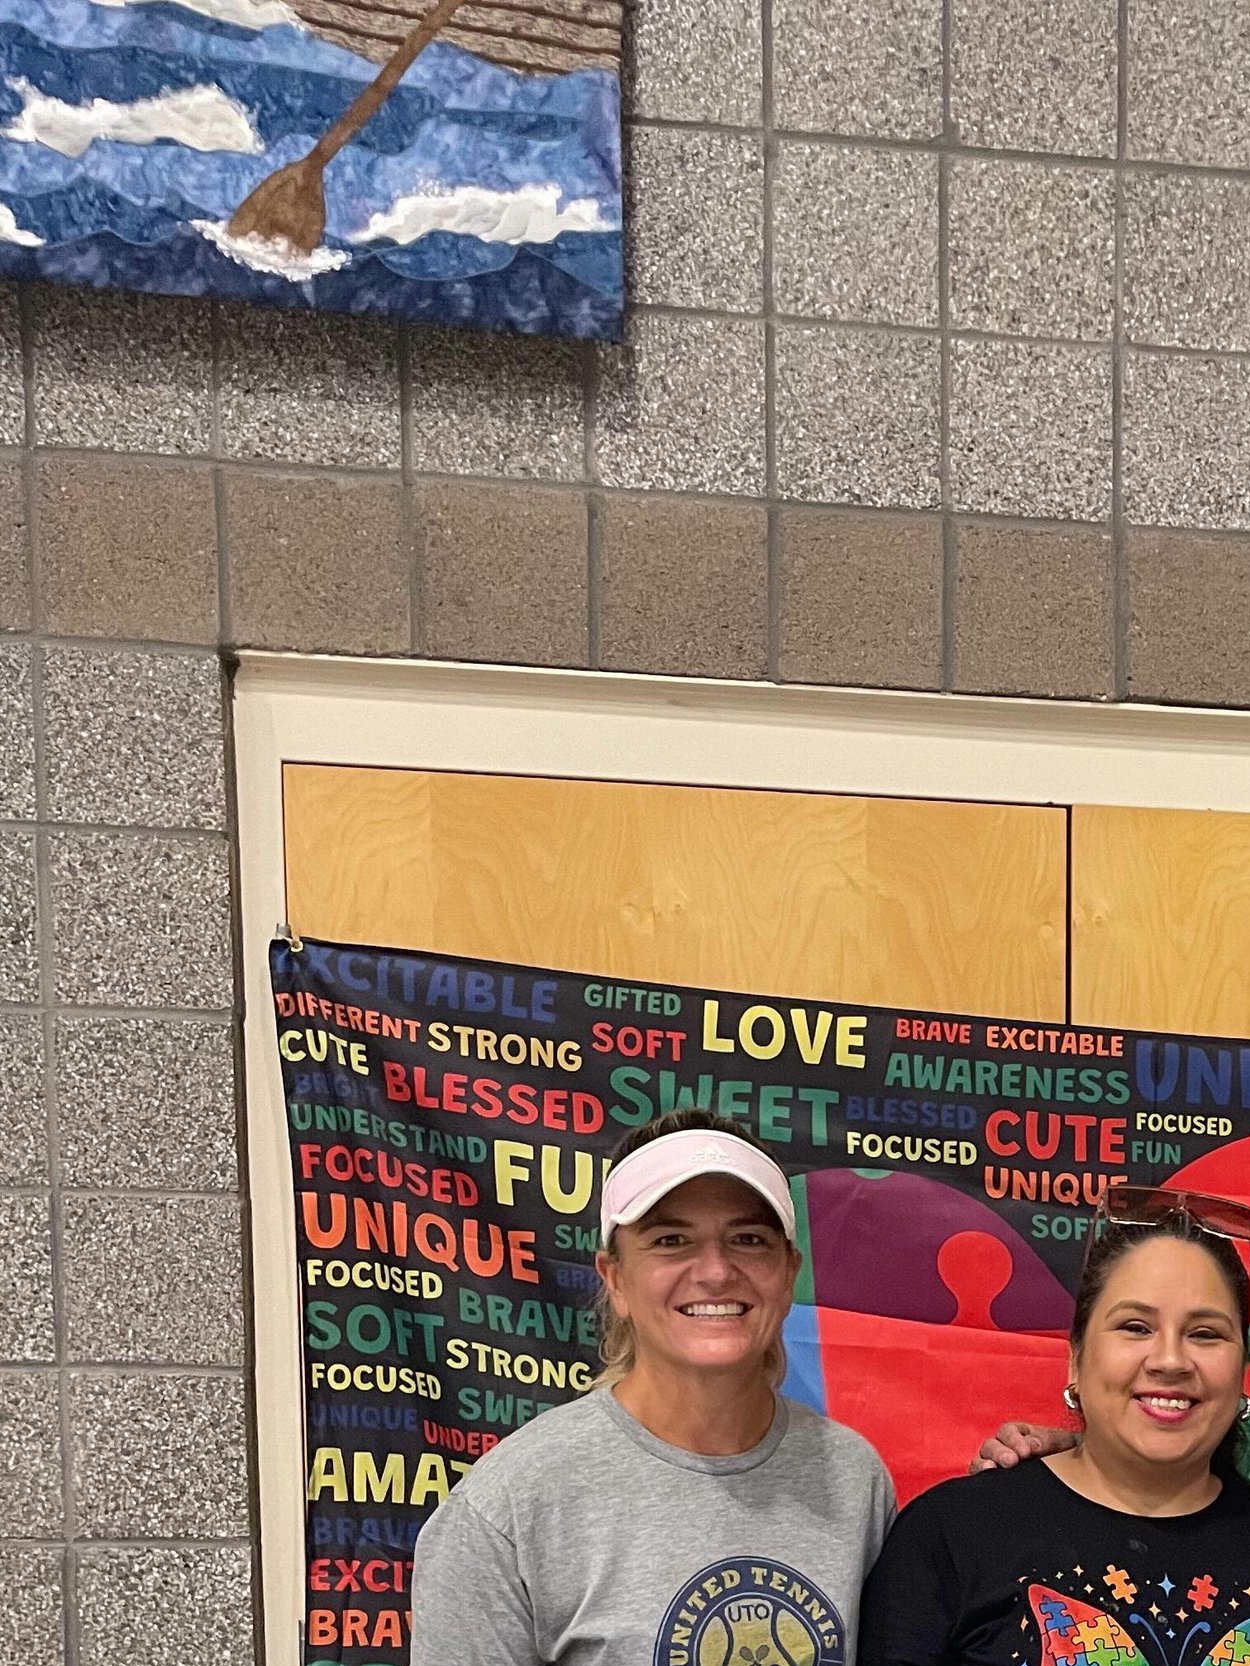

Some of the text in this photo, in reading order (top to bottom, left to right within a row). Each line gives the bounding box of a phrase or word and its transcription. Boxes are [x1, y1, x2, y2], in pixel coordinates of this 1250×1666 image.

[584, 984, 682, 1017] GIFTED
[275, 991, 583, 1072] DIFFERENT STRONG
[280, 1029, 370, 1075] CUTE
[591, 1022, 688, 1062] SOFT
[703, 999, 868, 1068] LOVE
[896, 1018, 1124, 1058] BRAVE EXCITABLE
[383, 1061, 606, 1134] BLESSED
[609, 1065, 841, 1147] SWEET
[884, 1051, 1131, 1106] AWARENESS
[290, 1103, 487, 1164] UNDERSTAND
[845, 1096, 977, 1131] BLESSED
[985, 1110, 1127, 1165] CUTE
[1136, 1112, 1233, 1137] FOCUSED
[301, 1144, 479, 1207] FOCUSED
[846, 1131, 977, 1166] FOCUSED
[1132, 1141, 1182, 1166] FUN
[493, 1139, 613, 1215] FU
[302, 1191, 540, 1285] UNIQUE
[307, 1260, 443, 1299] FOCUSED
[308, 1300, 444, 1364] SOFT
[458, 1287, 599, 1347] BRAVE
[311, 1363, 441, 1400] FOCUSED
[446, 1338, 592, 1392] STRONG
[670, 1566, 838, 1666] UNITED TENNIS
[727, 1602, 770, 1623] UTO
